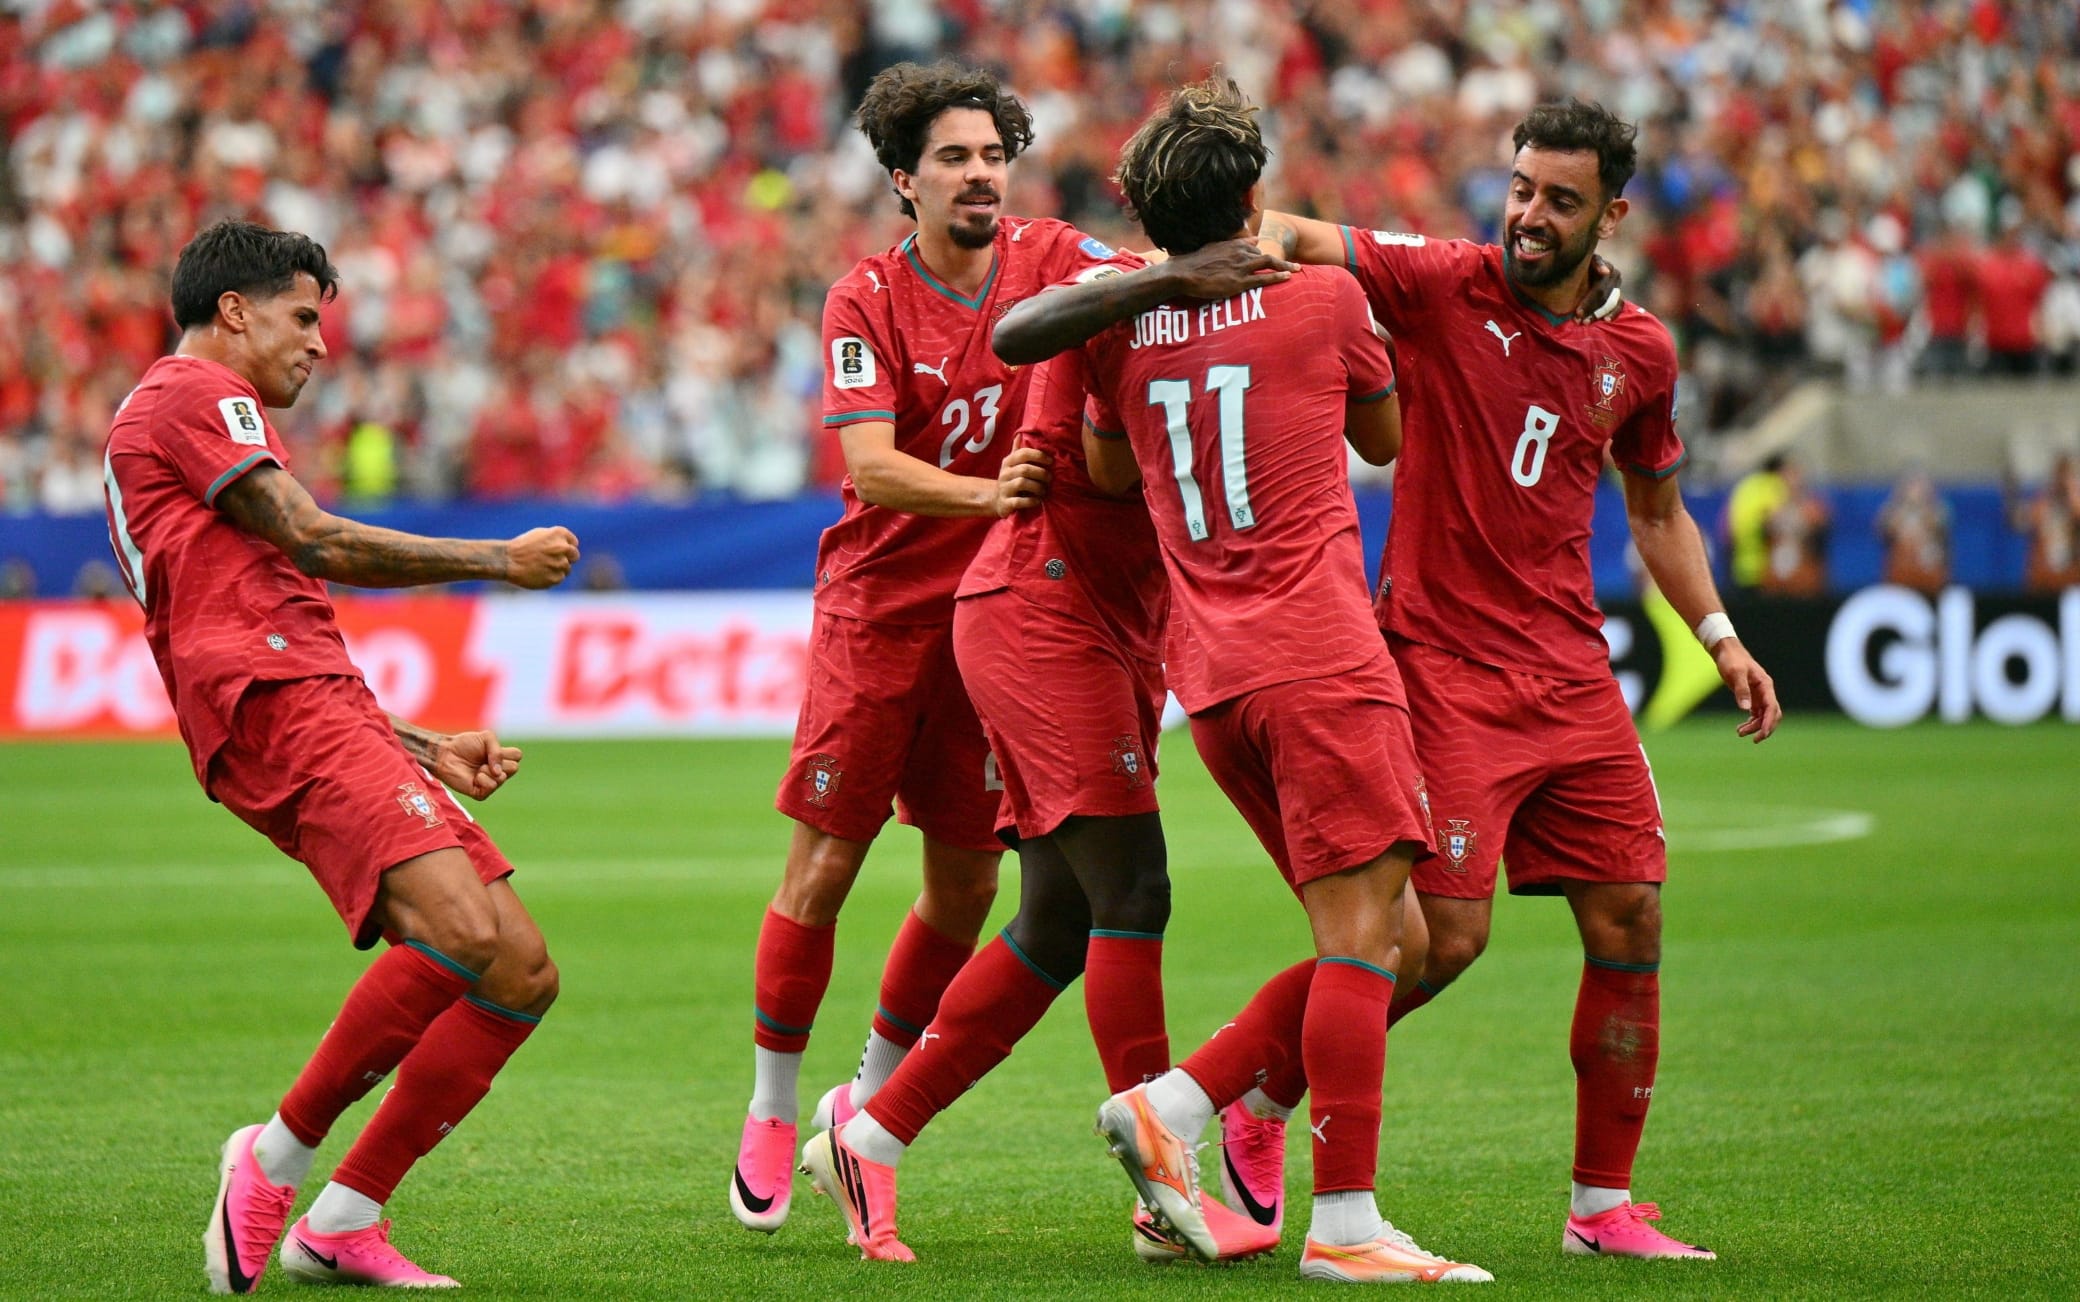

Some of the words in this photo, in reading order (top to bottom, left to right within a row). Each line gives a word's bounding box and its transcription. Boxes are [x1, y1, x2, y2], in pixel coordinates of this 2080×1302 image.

[1129, 304, 1189, 350] JOÃO
[939, 383, 1003, 470] 23
[1147, 364, 1257, 542] 11
[1510, 404, 1561, 488] 8
